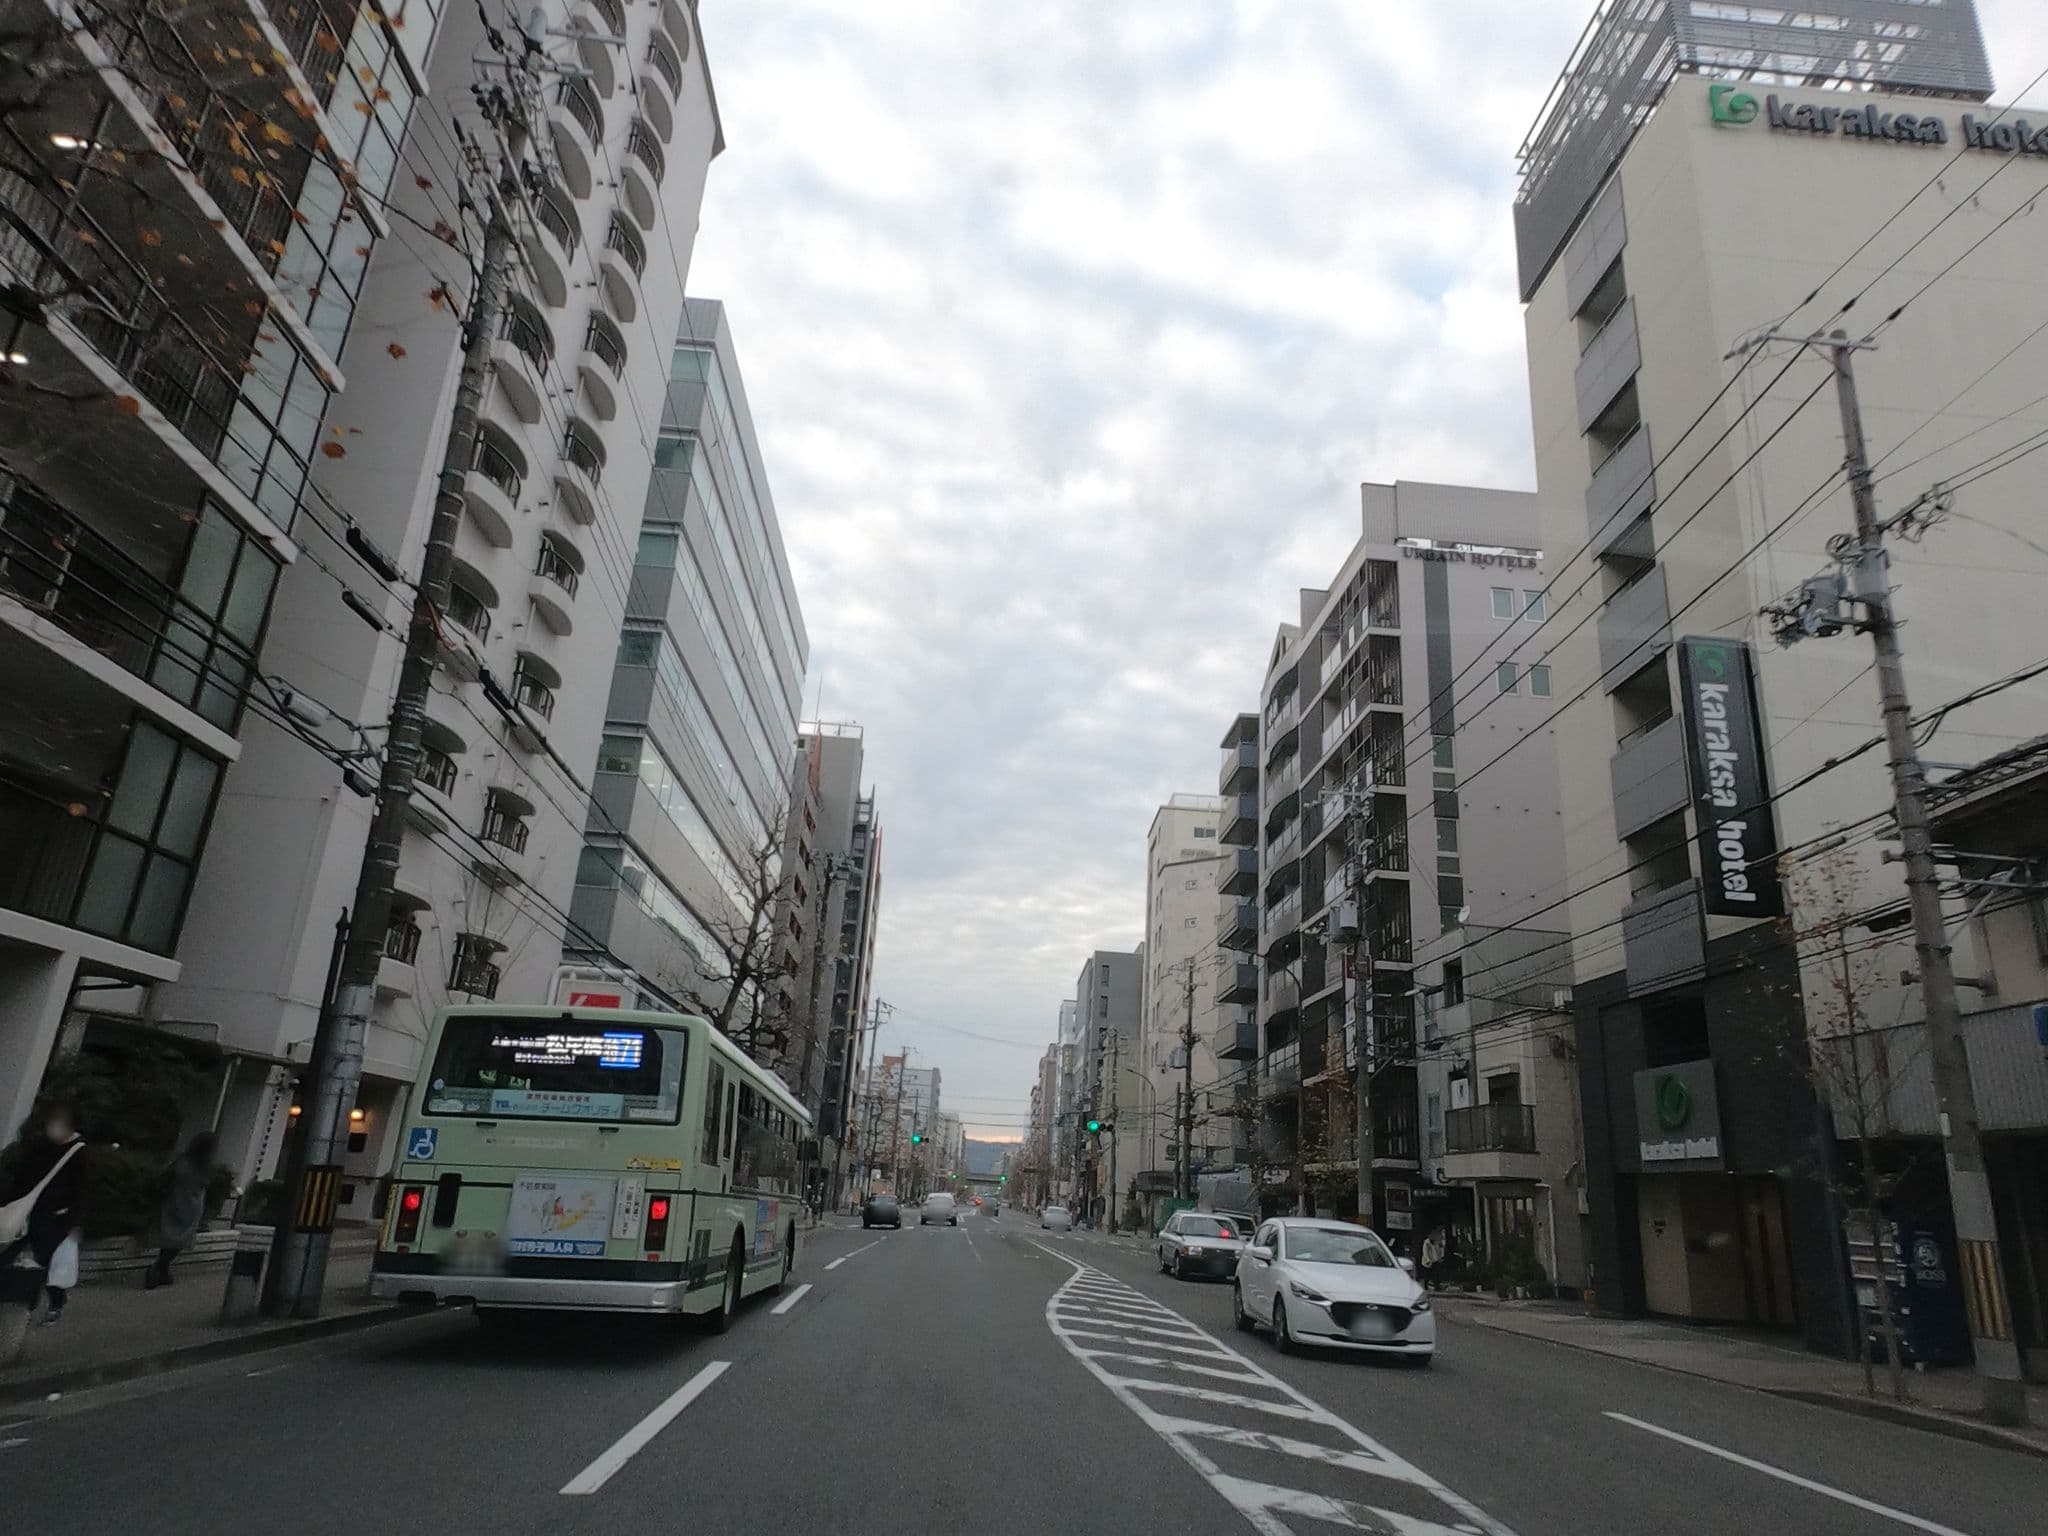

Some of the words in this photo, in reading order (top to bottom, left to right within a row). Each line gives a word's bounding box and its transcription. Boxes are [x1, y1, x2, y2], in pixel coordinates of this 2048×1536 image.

[1766, 94, 1949, 145] karaksa
[1471, 552, 1538, 569] HOTELS
[1700, 683, 1739, 808] karaksa
[1716, 818, 1757, 902] hotel
